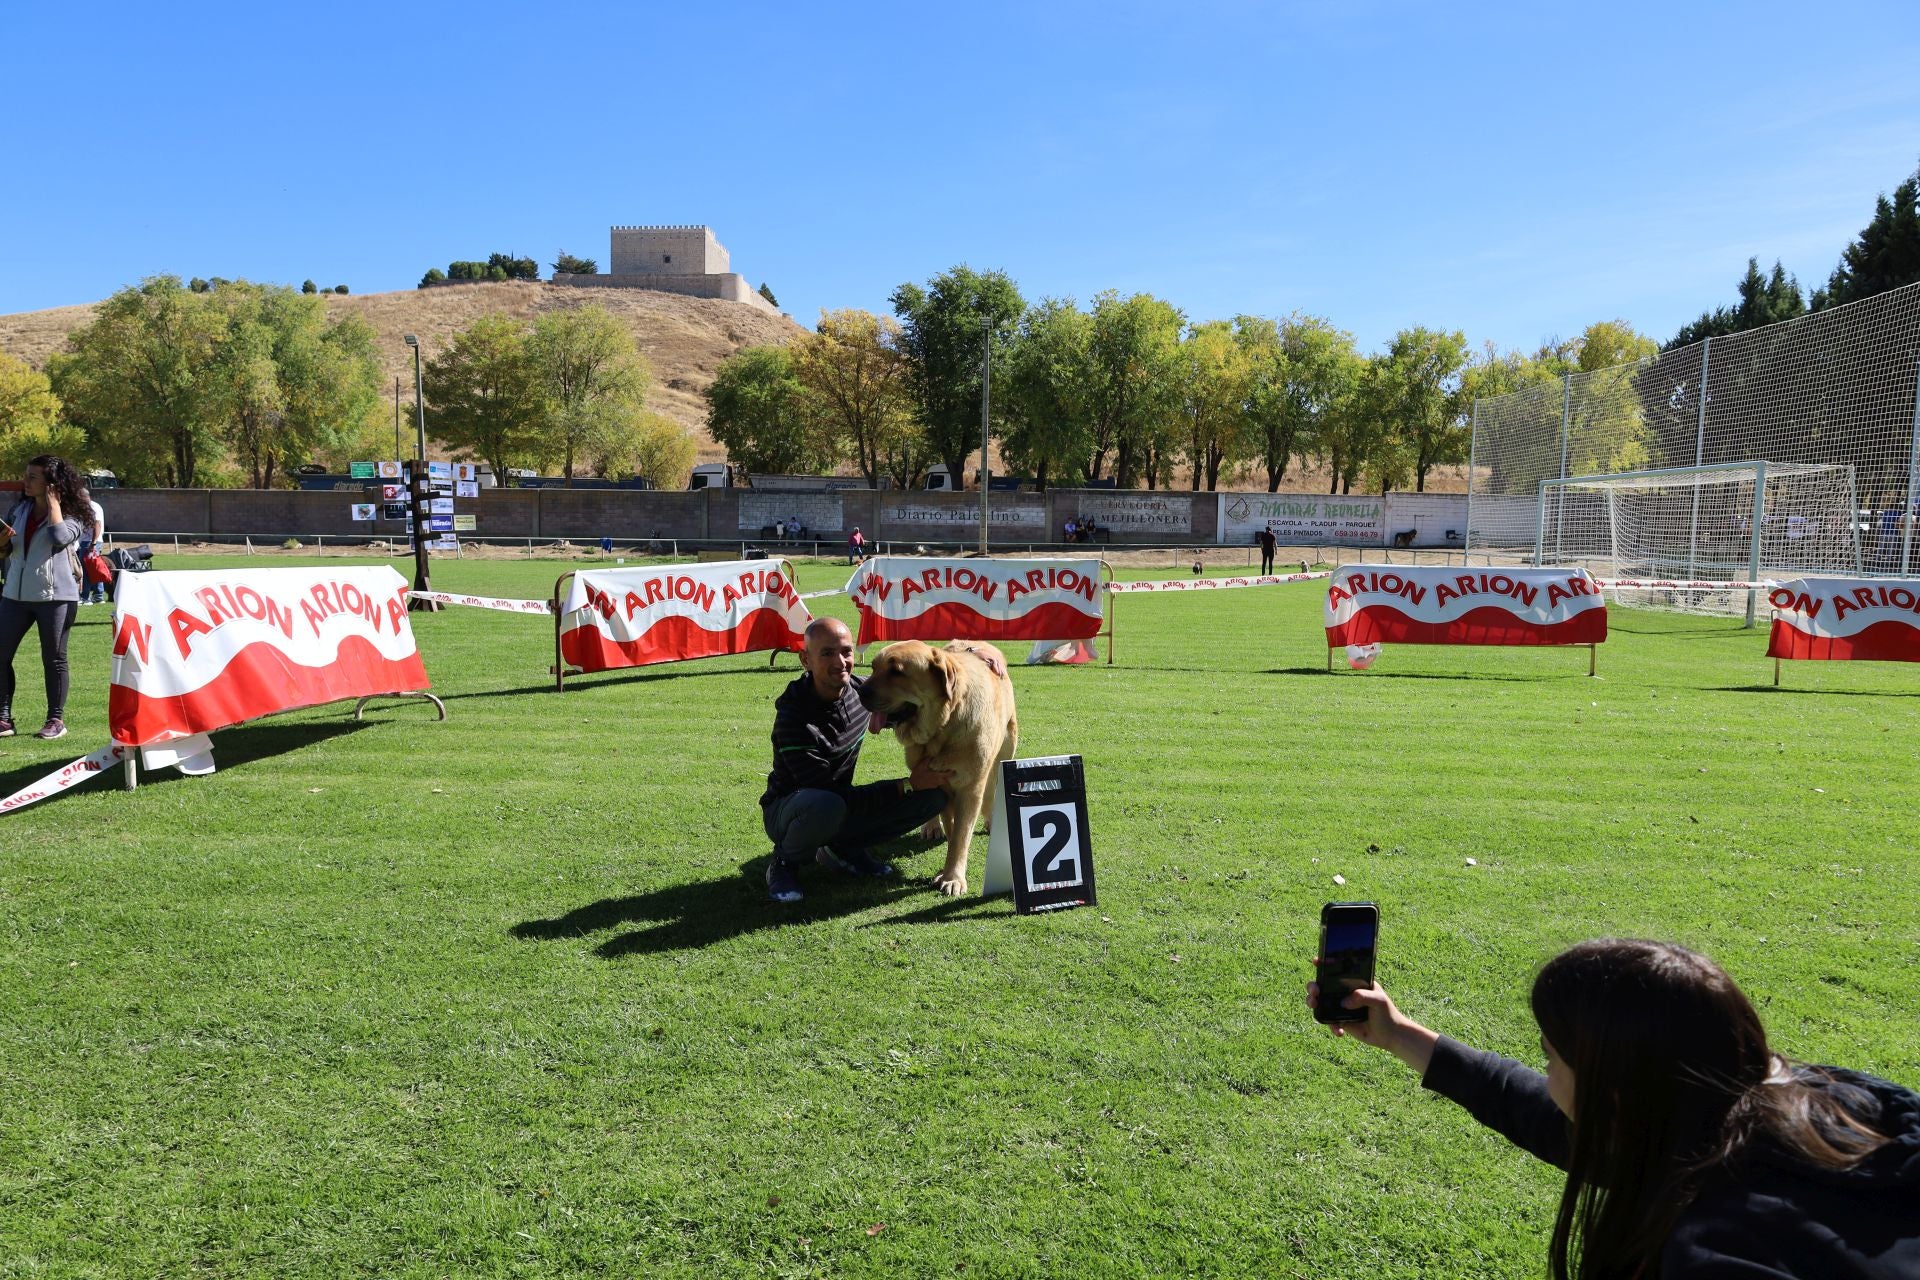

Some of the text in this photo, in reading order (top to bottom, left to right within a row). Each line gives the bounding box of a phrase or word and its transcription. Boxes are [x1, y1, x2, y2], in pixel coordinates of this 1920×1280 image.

[897, 508, 1020, 522] Diario Paletino
[1293, 529, 1323, 537] PINTADOS
[625, 575, 715, 622] ARION
[722, 570, 799, 613] ARION
[901, 568, 998, 604] ARION
[1006, 568, 1098, 604] ARION
[1131, 582, 1154, 591] ARION
[1162, 581, 1186, 590] ARION
[1193, 580, 1217, 588] ARION
[1225, 578, 1248, 587] ARION
[1256, 576, 1280, 584] ARION
[1287, 574, 1312, 582] ARION
[1328, 573, 1427, 613] ARION
[1434, 574, 1538, 609] ARION
[521, 601, 544, 612] ARION
[1768, 587, 1822, 619] ON
[167, 583, 293, 661] ARION
[301, 581, 381, 638] ARION
[1029, 810, 1077, 885] 2
